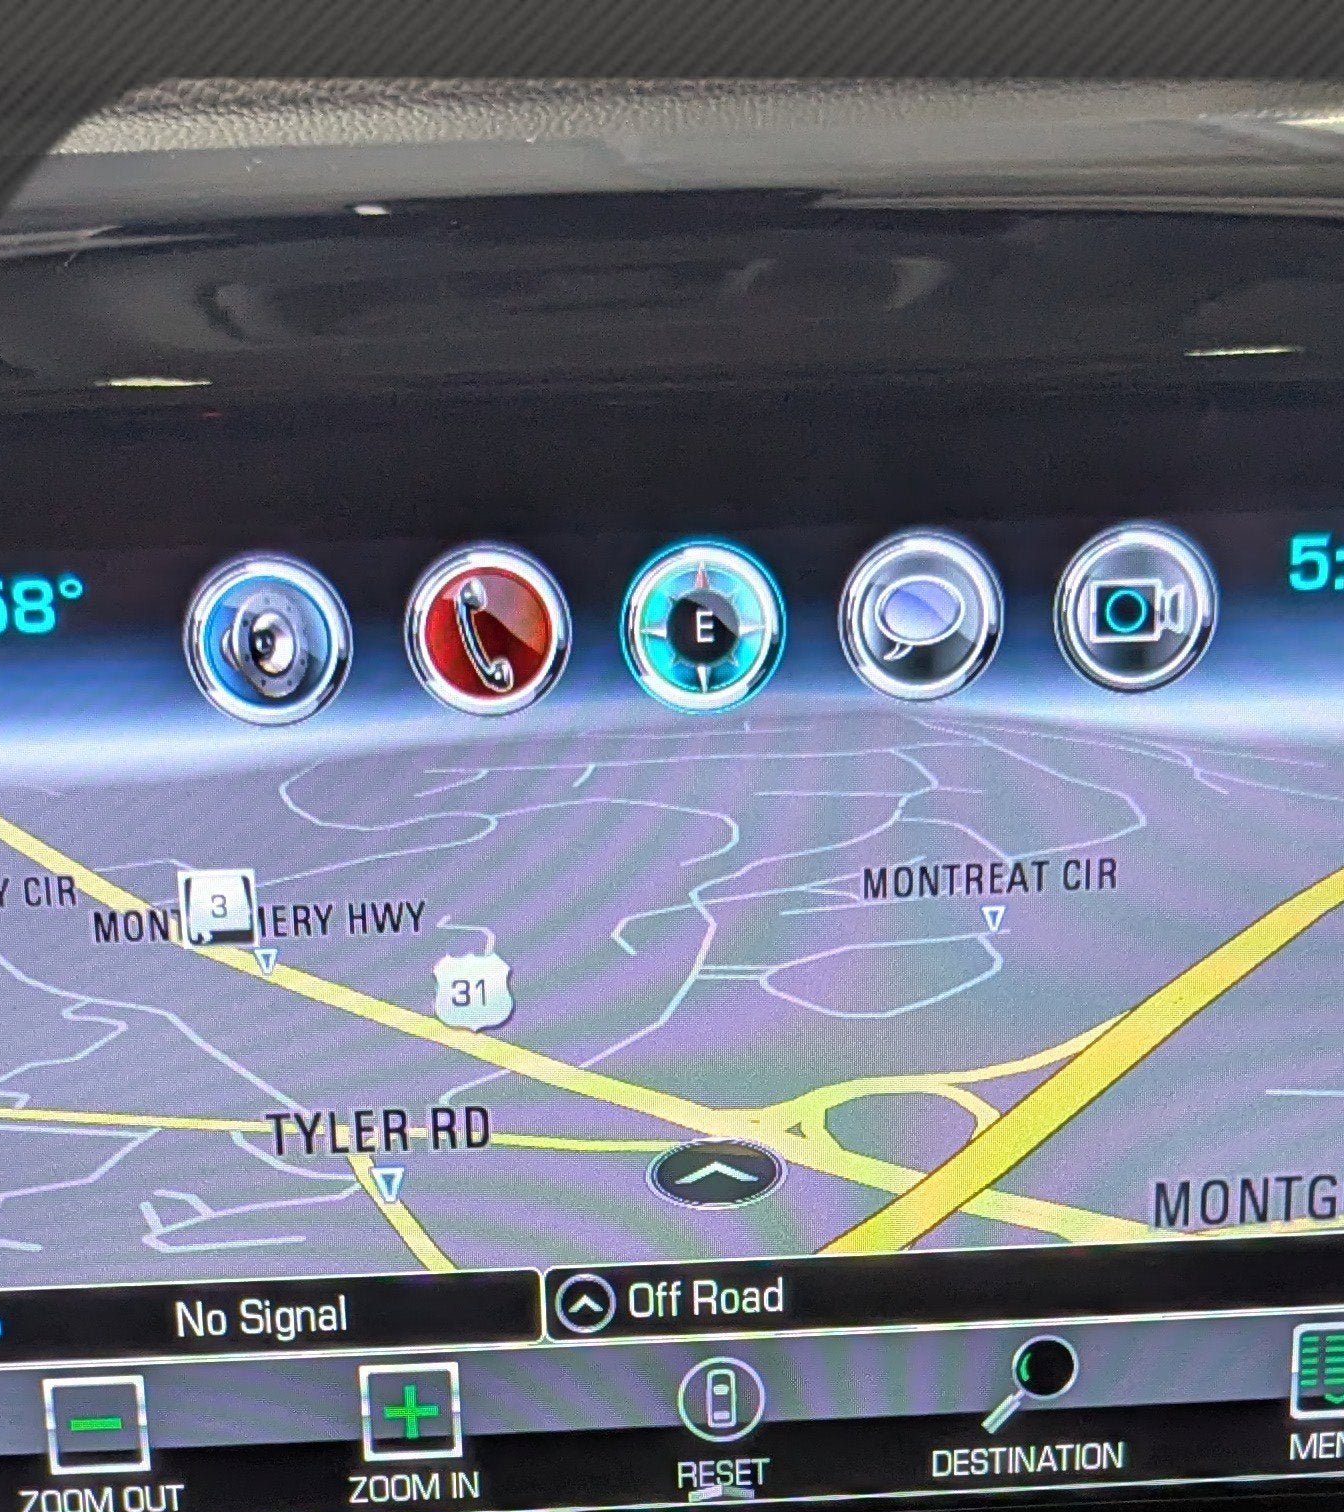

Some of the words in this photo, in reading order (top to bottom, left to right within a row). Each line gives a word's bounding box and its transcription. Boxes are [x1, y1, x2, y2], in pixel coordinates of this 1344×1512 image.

[695, 610, 716, 644] E
[23, 875, 78, 908] CIR
[863, 861, 1049, 900] MONTREAT
[1063, 857, 1118, 893] CIR
[210, 893, 229, 919] 3
[348, 900, 426, 935] HWY
[450, 976, 489, 1008] 31
[265, 1107, 413, 1157] TYLER
[431, 1104, 492, 1150] RD
[628, 1279, 683, 1320] Off
[692, 1275, 785, 1317] Road
[176, 1303, 229, 1339] No
[239, 1295, 348, 1343] Signal
[676, 1457, 772, 1490] RESET
[930, 1441, 1126, 1479] DESTINATION
[348, 1472, 442, 1506] ZOOM
[451, 1469, 482, 1502] IN
